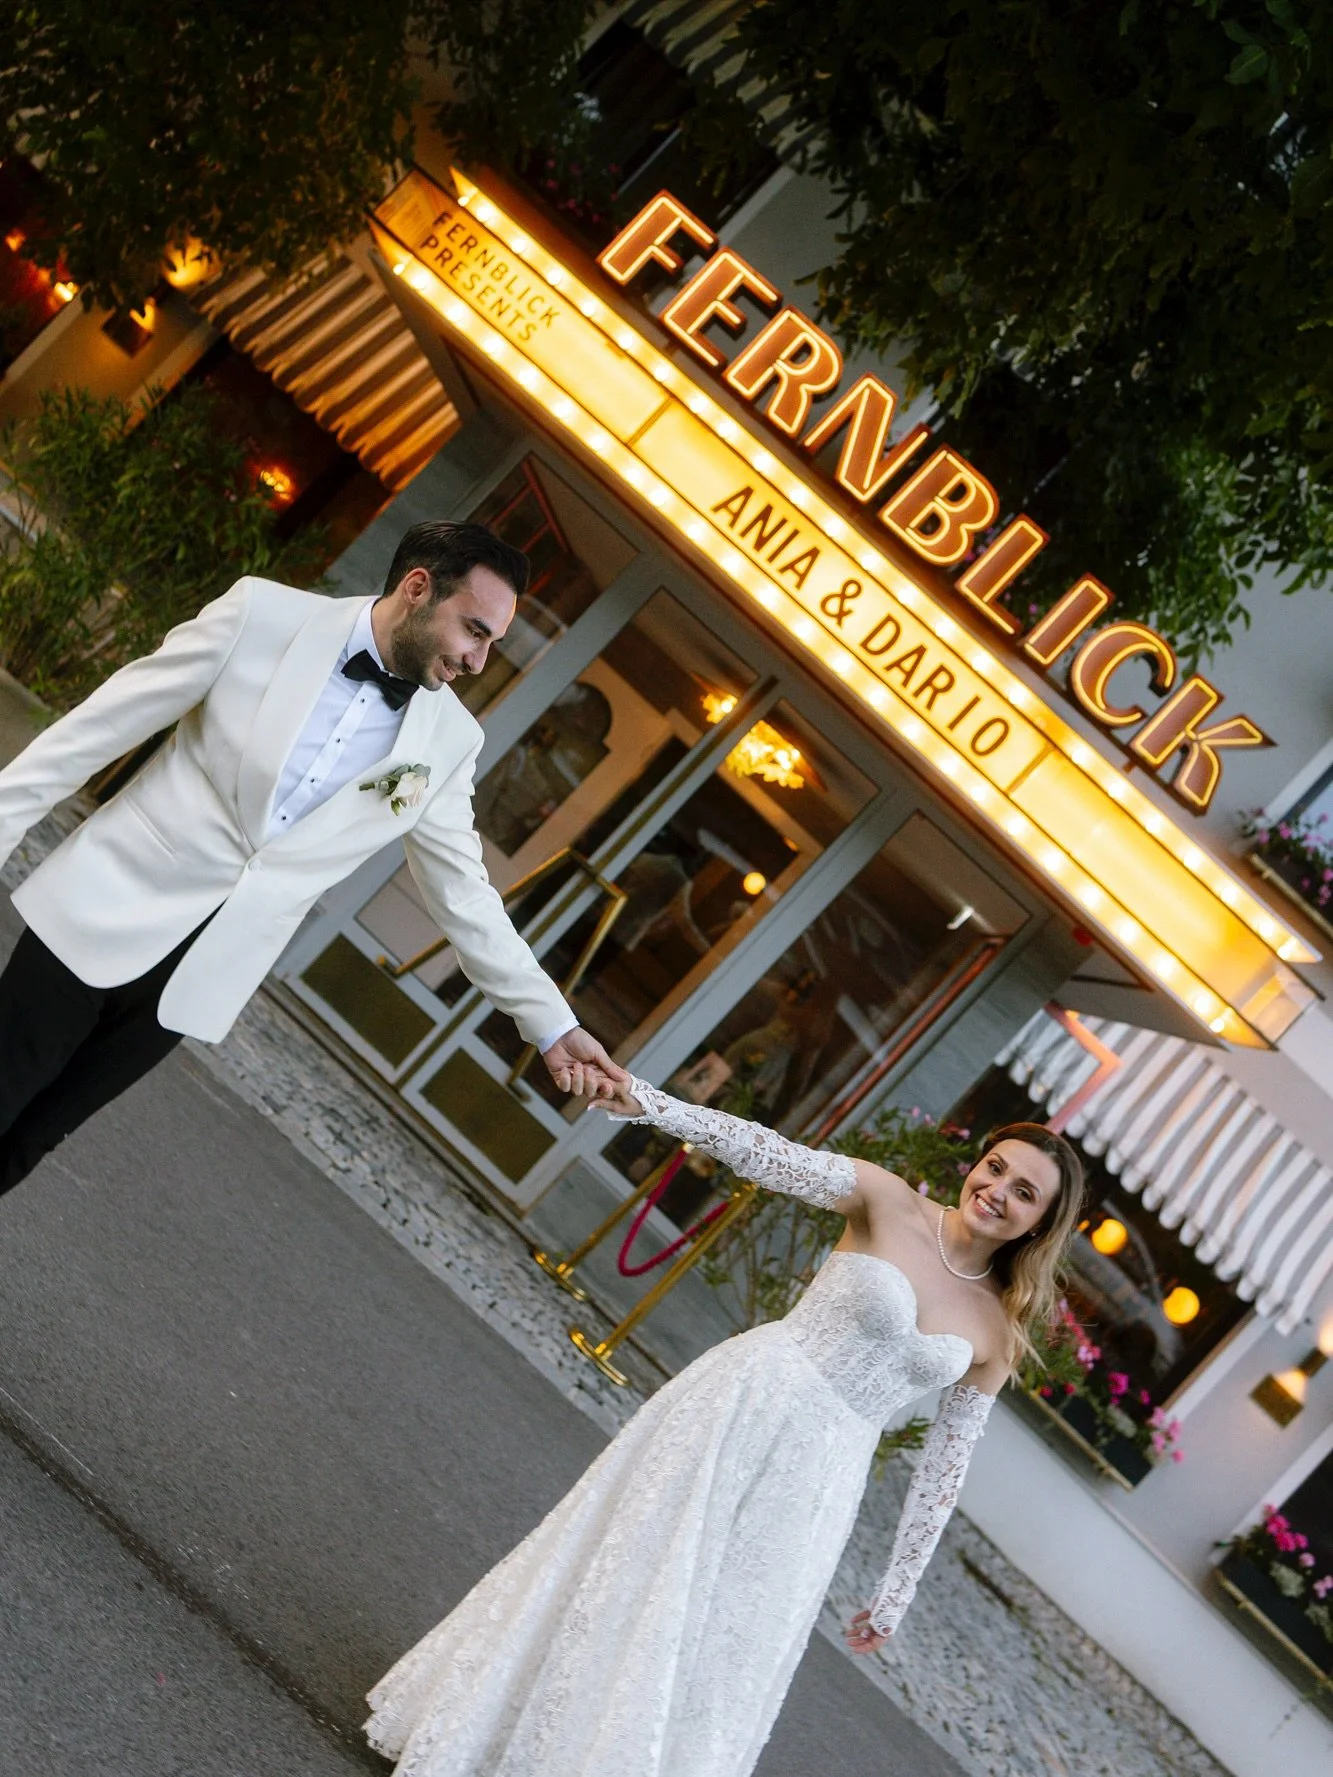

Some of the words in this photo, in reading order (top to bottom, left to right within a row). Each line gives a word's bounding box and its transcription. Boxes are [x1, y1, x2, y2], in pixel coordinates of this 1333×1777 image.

[421, 237, 538, 341] PRESENTS
[433, 212, 560, 327] FERNBLICK
[597, 189, 1276, 815] FERNBLICK
[711, 486, 820, 590] ANIA
[821, 579, 863, 627] &
[859, 614, 1010, 757] DARIO
